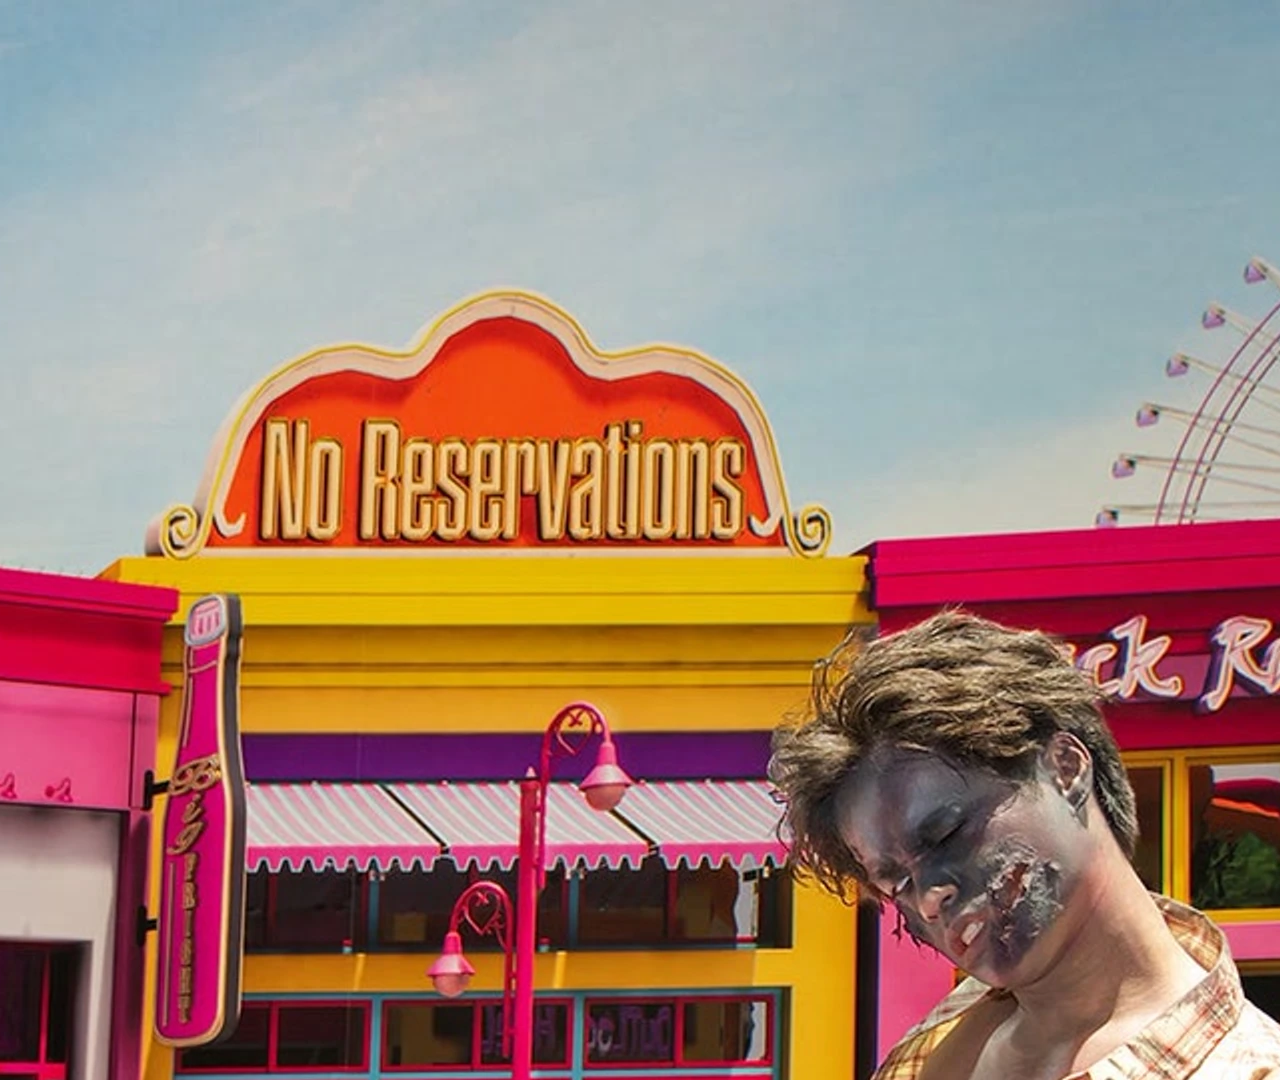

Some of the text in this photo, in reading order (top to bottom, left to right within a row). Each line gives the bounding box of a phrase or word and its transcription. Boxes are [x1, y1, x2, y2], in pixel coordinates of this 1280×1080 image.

[260, 418, 745, 542] No Reservations
[1060, 613, 1183, 698] ck
